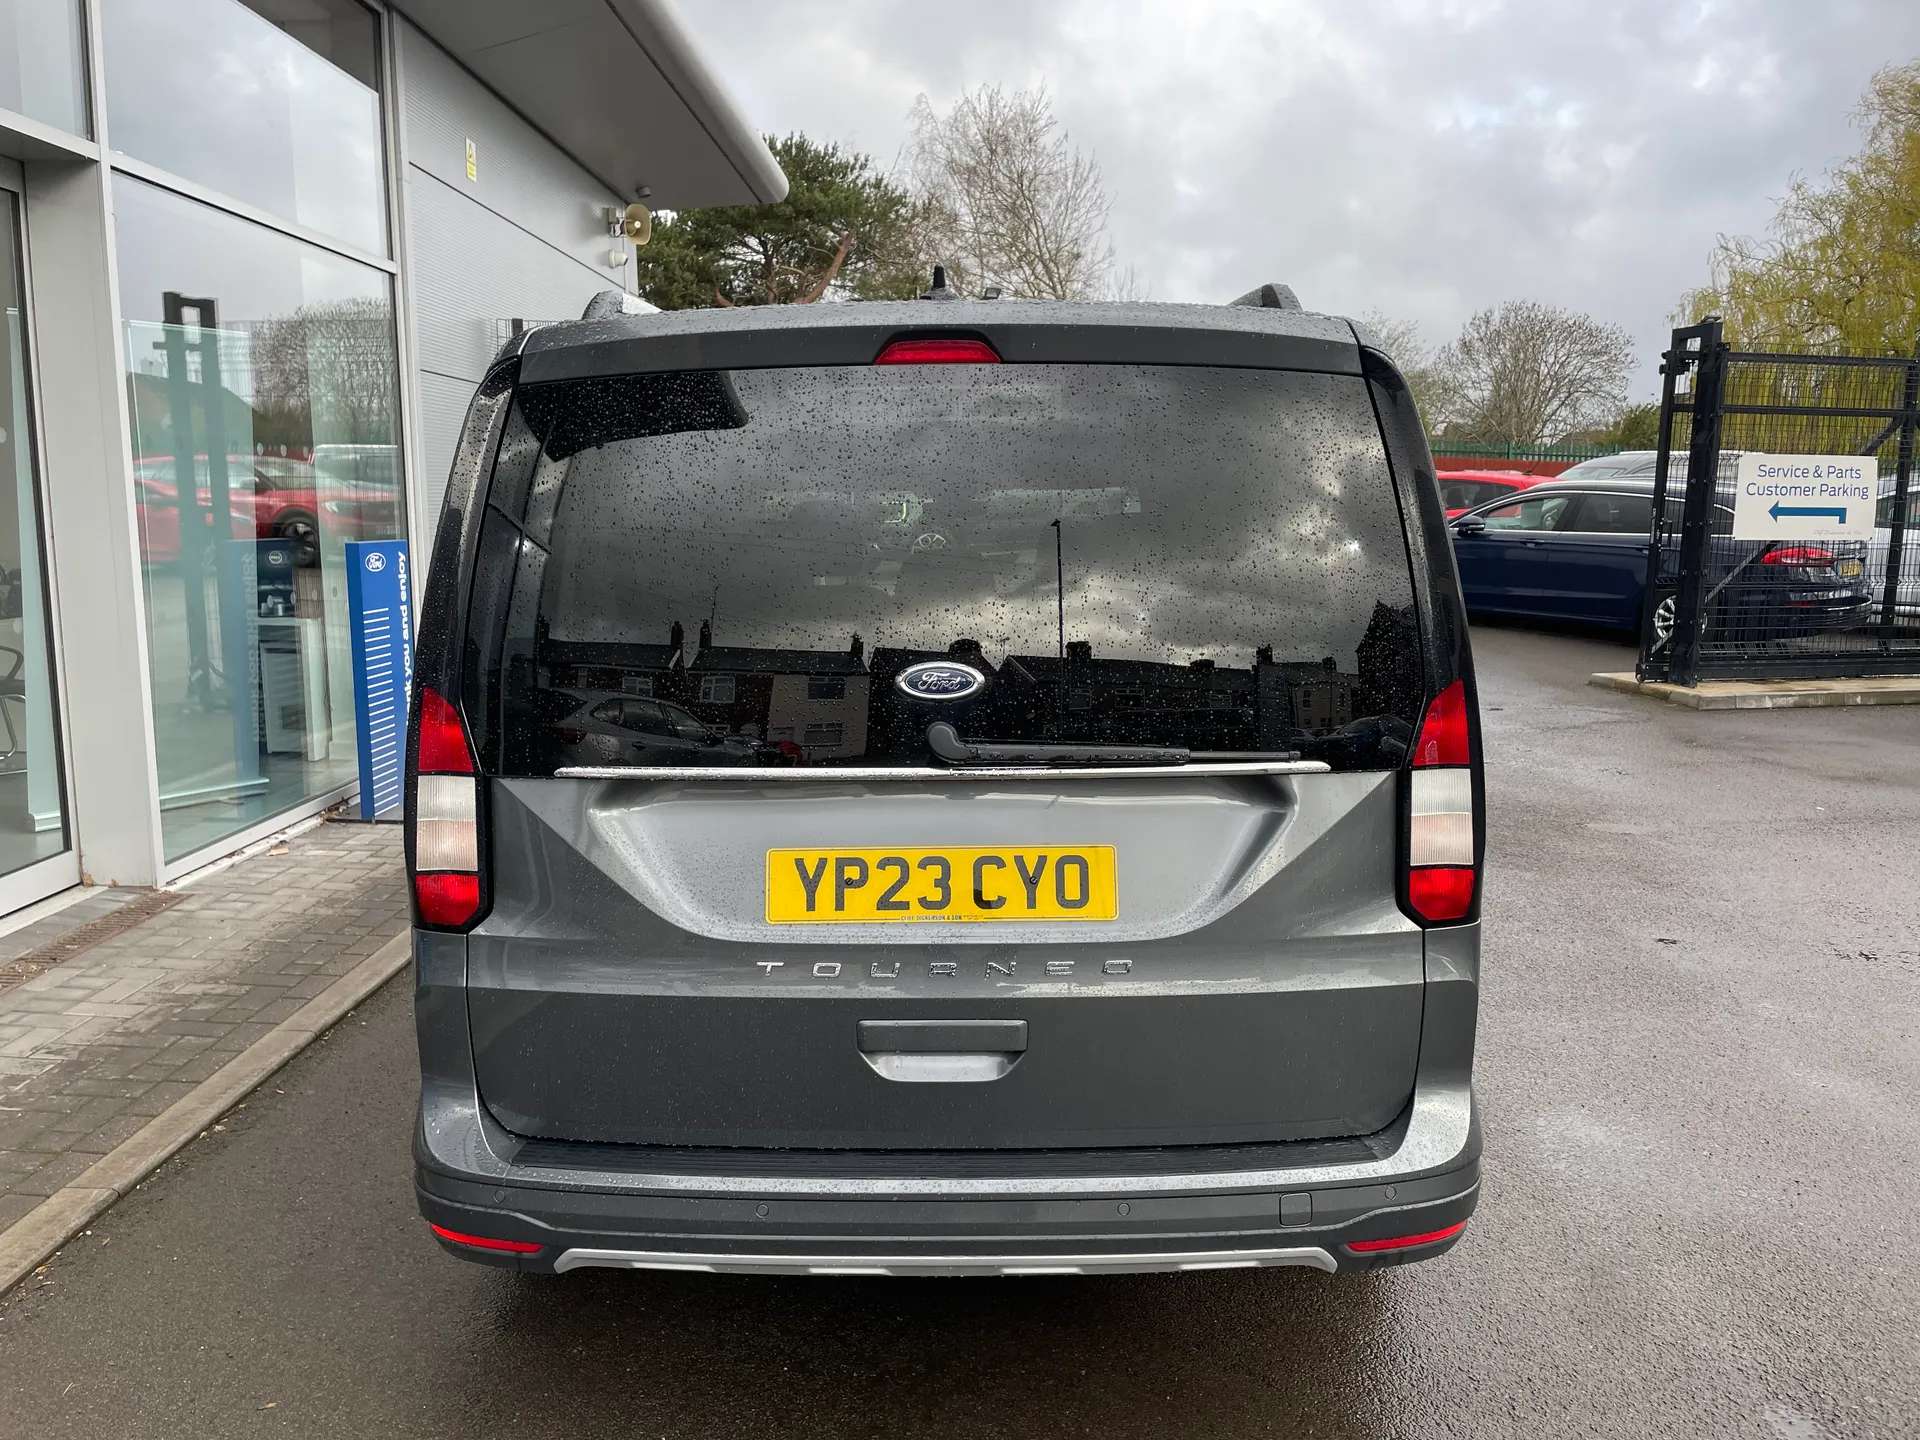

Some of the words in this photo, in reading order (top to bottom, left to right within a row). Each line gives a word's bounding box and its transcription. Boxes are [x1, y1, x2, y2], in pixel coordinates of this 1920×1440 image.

[1757, 464, 1810, 478] Service
[1813, 464, 1823, 478] &
[1827, 465, 1862, 479] Parts
[1746, 482, 1816, 497] Customer
[1820, 483, 1869, 500] Parking
[398, 551, 408, 602] enjoy
[400, 604, 409, 641] and
[403, 643, 412, 678] you
[917, 671, 961, 690] Ford
[794, 855, 952, 912] YP23
[972, 854, 1090, 910] CYO
[756, 959, 1133, 980] TOURNEO
